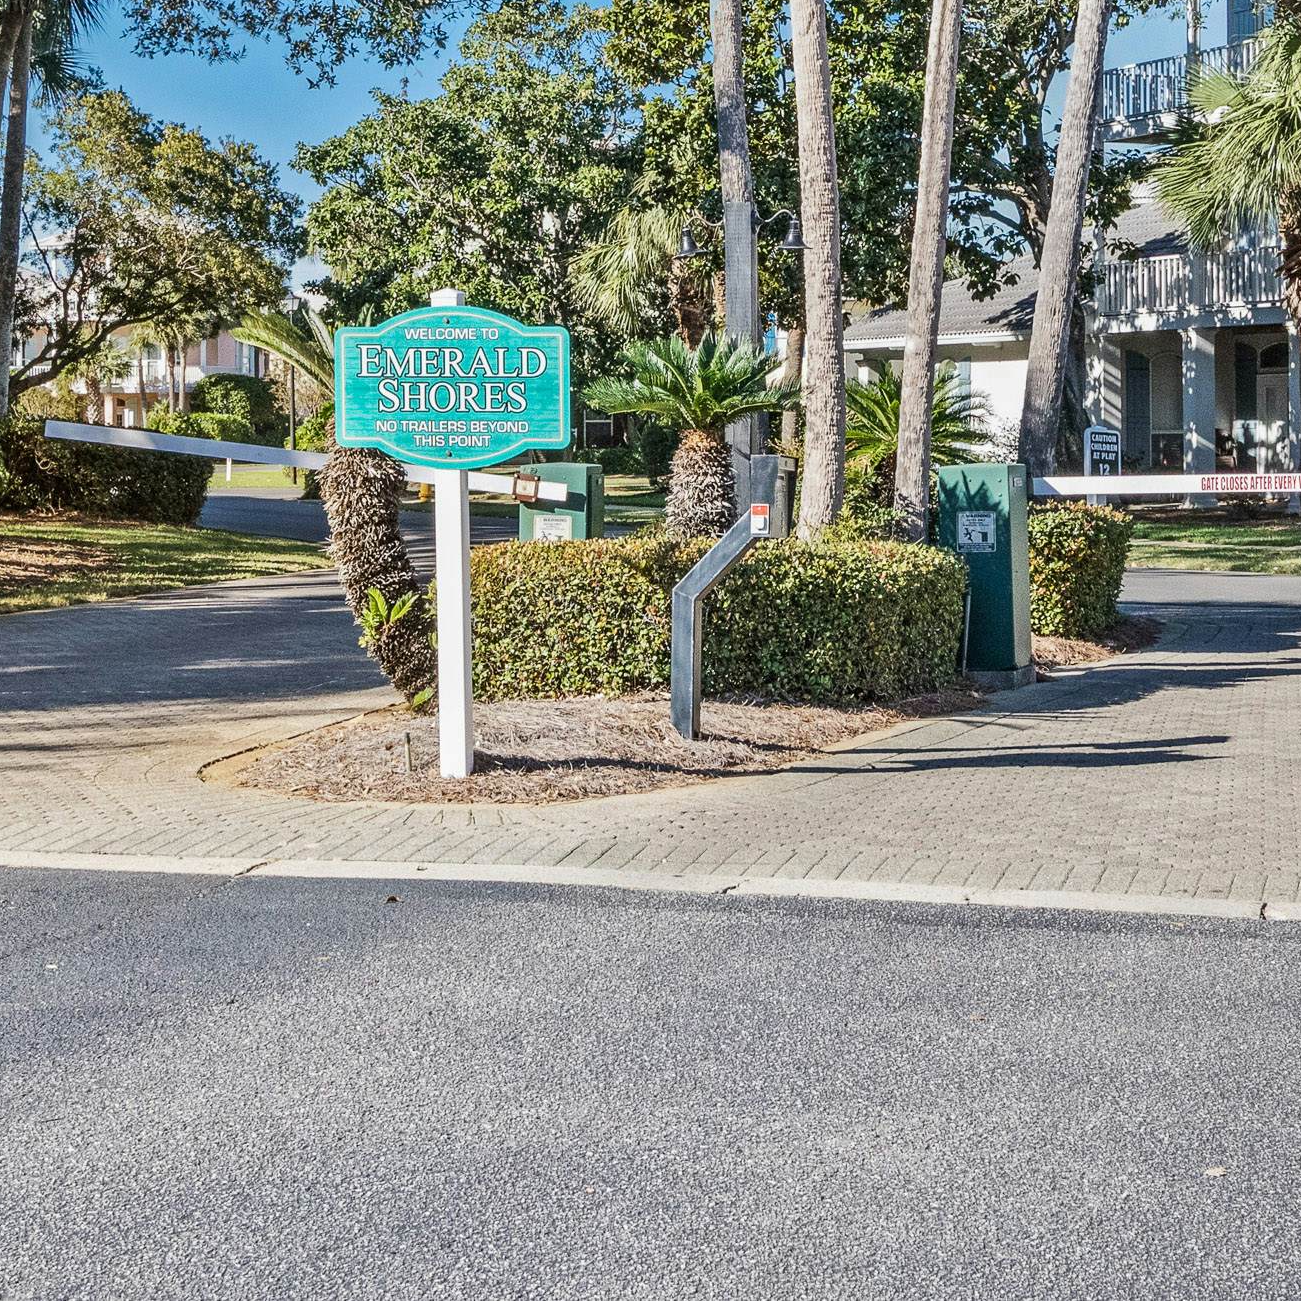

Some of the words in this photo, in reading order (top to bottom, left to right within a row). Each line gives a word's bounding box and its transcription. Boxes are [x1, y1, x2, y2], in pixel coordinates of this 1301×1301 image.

[404, 328, 477, 341] WELCOME
[481, 328, 499, 340] TO
[356, 343, 547, 378] EMERALD
[377, 378, 528, 414] SHORES
[376, 420, 398, 432] NO
[401, 420, 467, 432] TRAILERS
[471, 421, 529, 433] BEYOND
[413, 435, 448, 447] THIS
[449, 435, 491, 447] POINT
[1092, 434, 1117, 443] CAUTION
[1091, 443, 1118, 452] CHILDREN
[1093, 451, 1100, 459] AT
[1101, 452, 1116, 461] PLAY
[1099, 463, 1110, 476] 12
[1201, 477, 1219, 491] GATE
[1220, 476, 1249, 490] CLOSES
[1250, 476, 1272, 490] AFTER
[1274, 475, 1297, 490] EVERY
